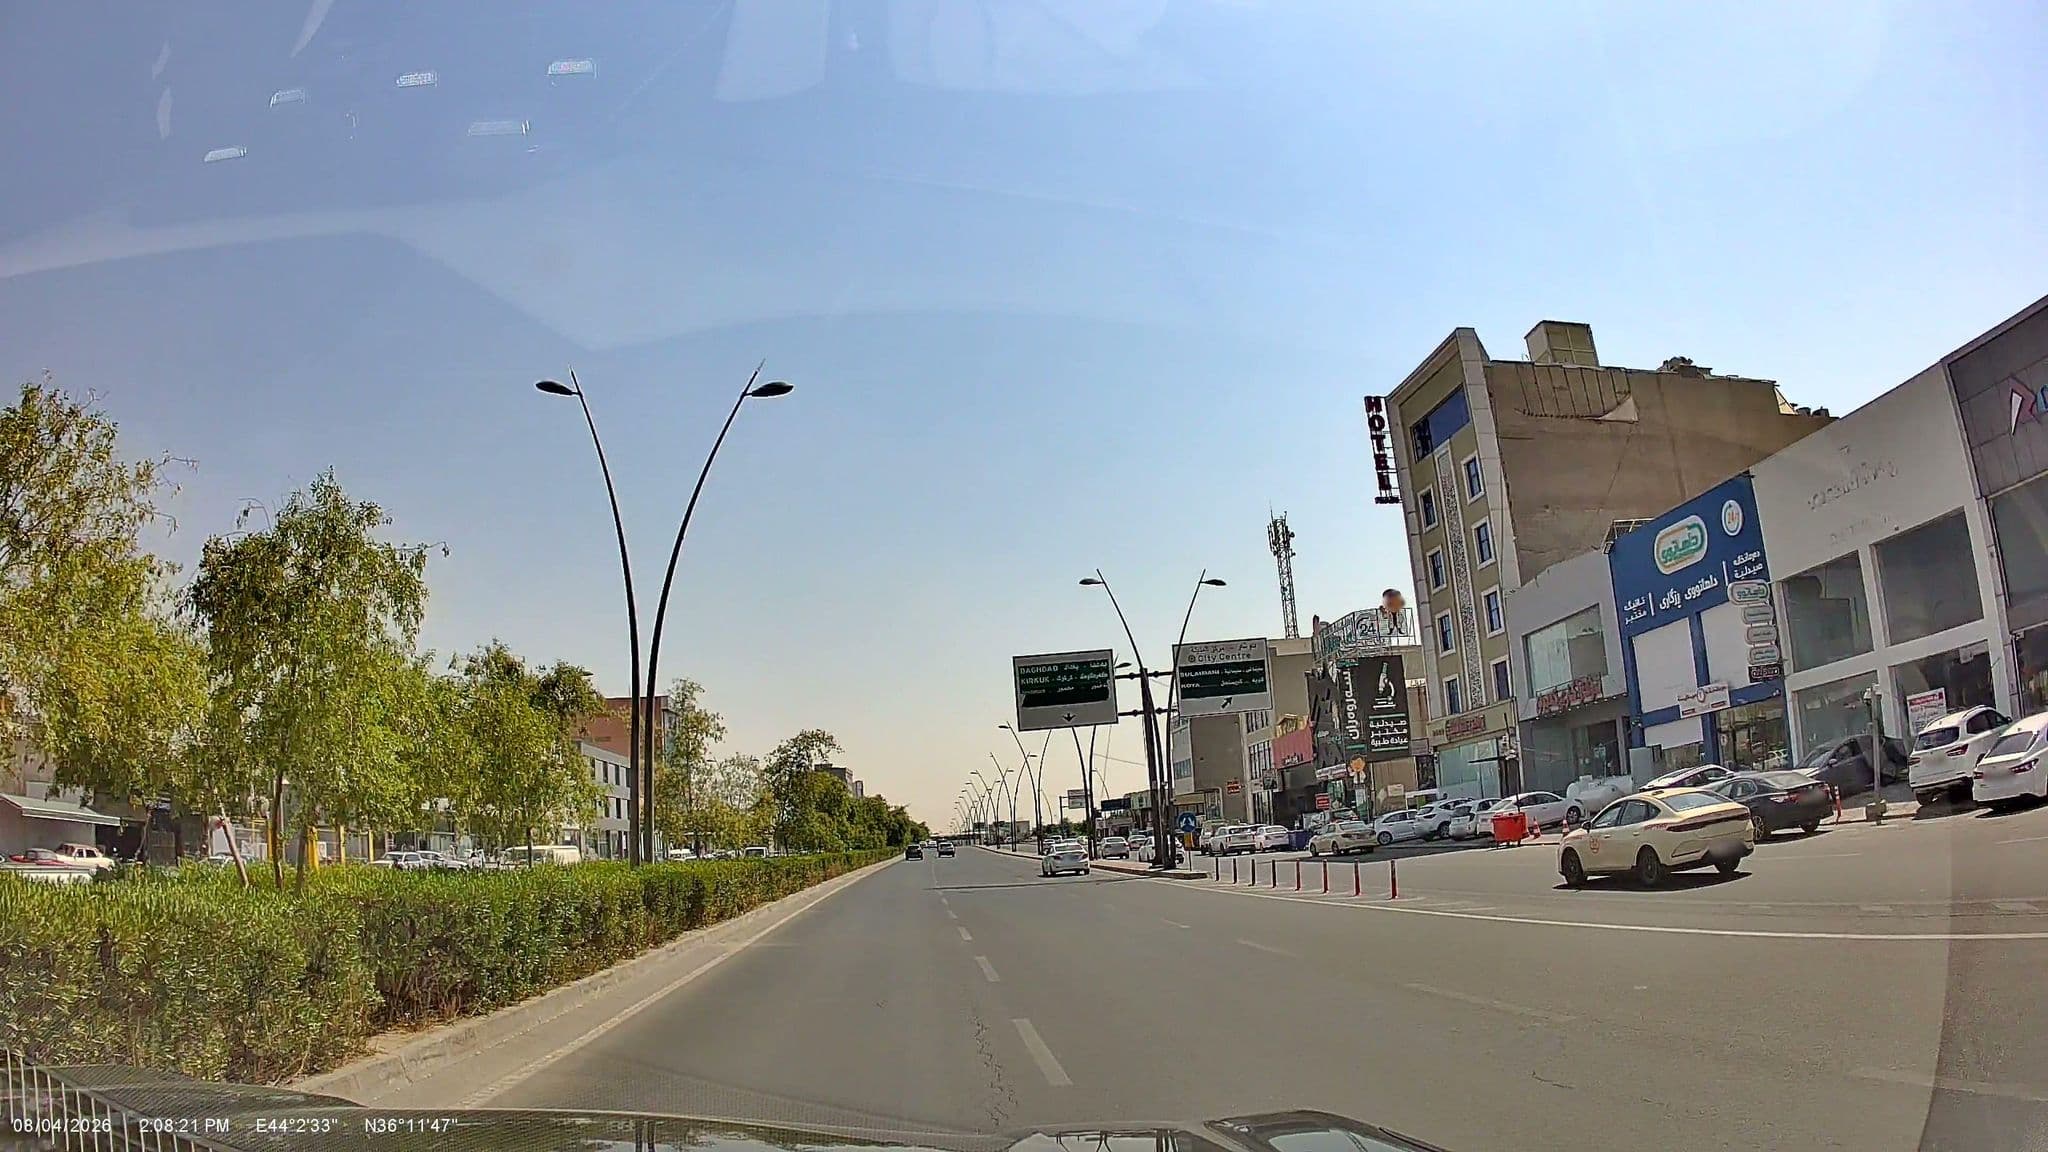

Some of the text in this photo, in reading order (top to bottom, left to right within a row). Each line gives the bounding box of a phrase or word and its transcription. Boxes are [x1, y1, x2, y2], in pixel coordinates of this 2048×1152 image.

[1364, 396, 1391, 491] HOTEL
[1360, 622, 1376, 636] 24
[1198, 652, 1251, 662] City Centre
[1021, 676, 1050, 685] KIRKUK
[1370, 719, 1407, 729] صيدلية
[1370, 728, 1408, 738] مختبر
[1370, 736, 1409, 747] عيادة طبية
